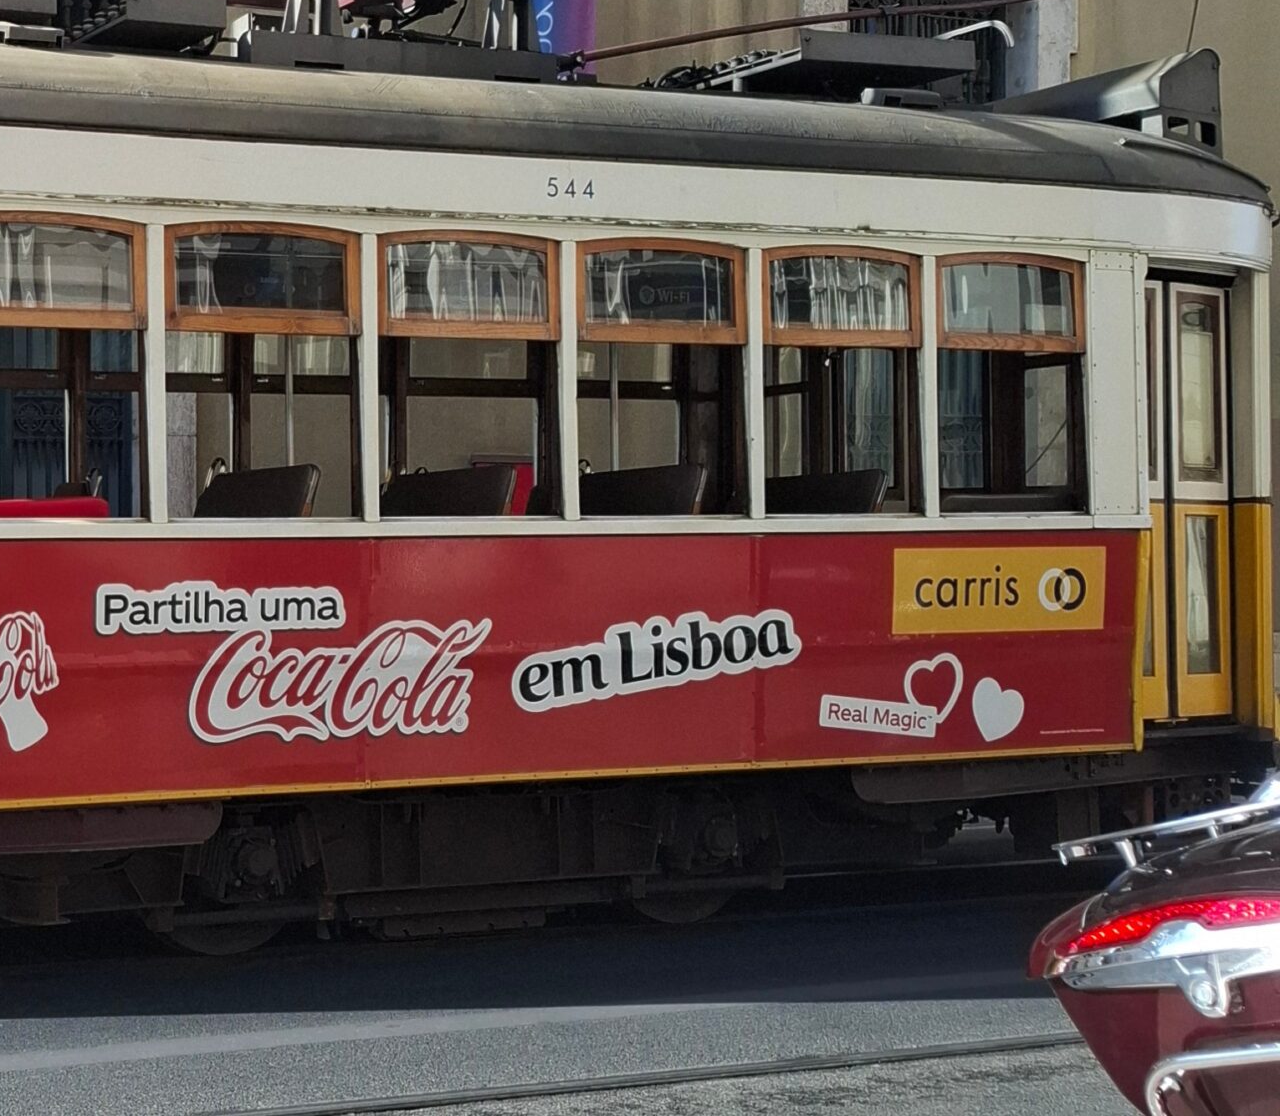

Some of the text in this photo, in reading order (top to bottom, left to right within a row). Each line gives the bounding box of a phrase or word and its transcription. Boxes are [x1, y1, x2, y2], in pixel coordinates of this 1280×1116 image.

[547, 177, 594, 199] 544
[658, 290, 690, 304] WI-FI
[915, 565, 1020, 608] carris
[104, 590, 339, 626] Partilha uma
[520, 618, 794, 702] em Lisboa
[828, 702, 867, 724] Real
